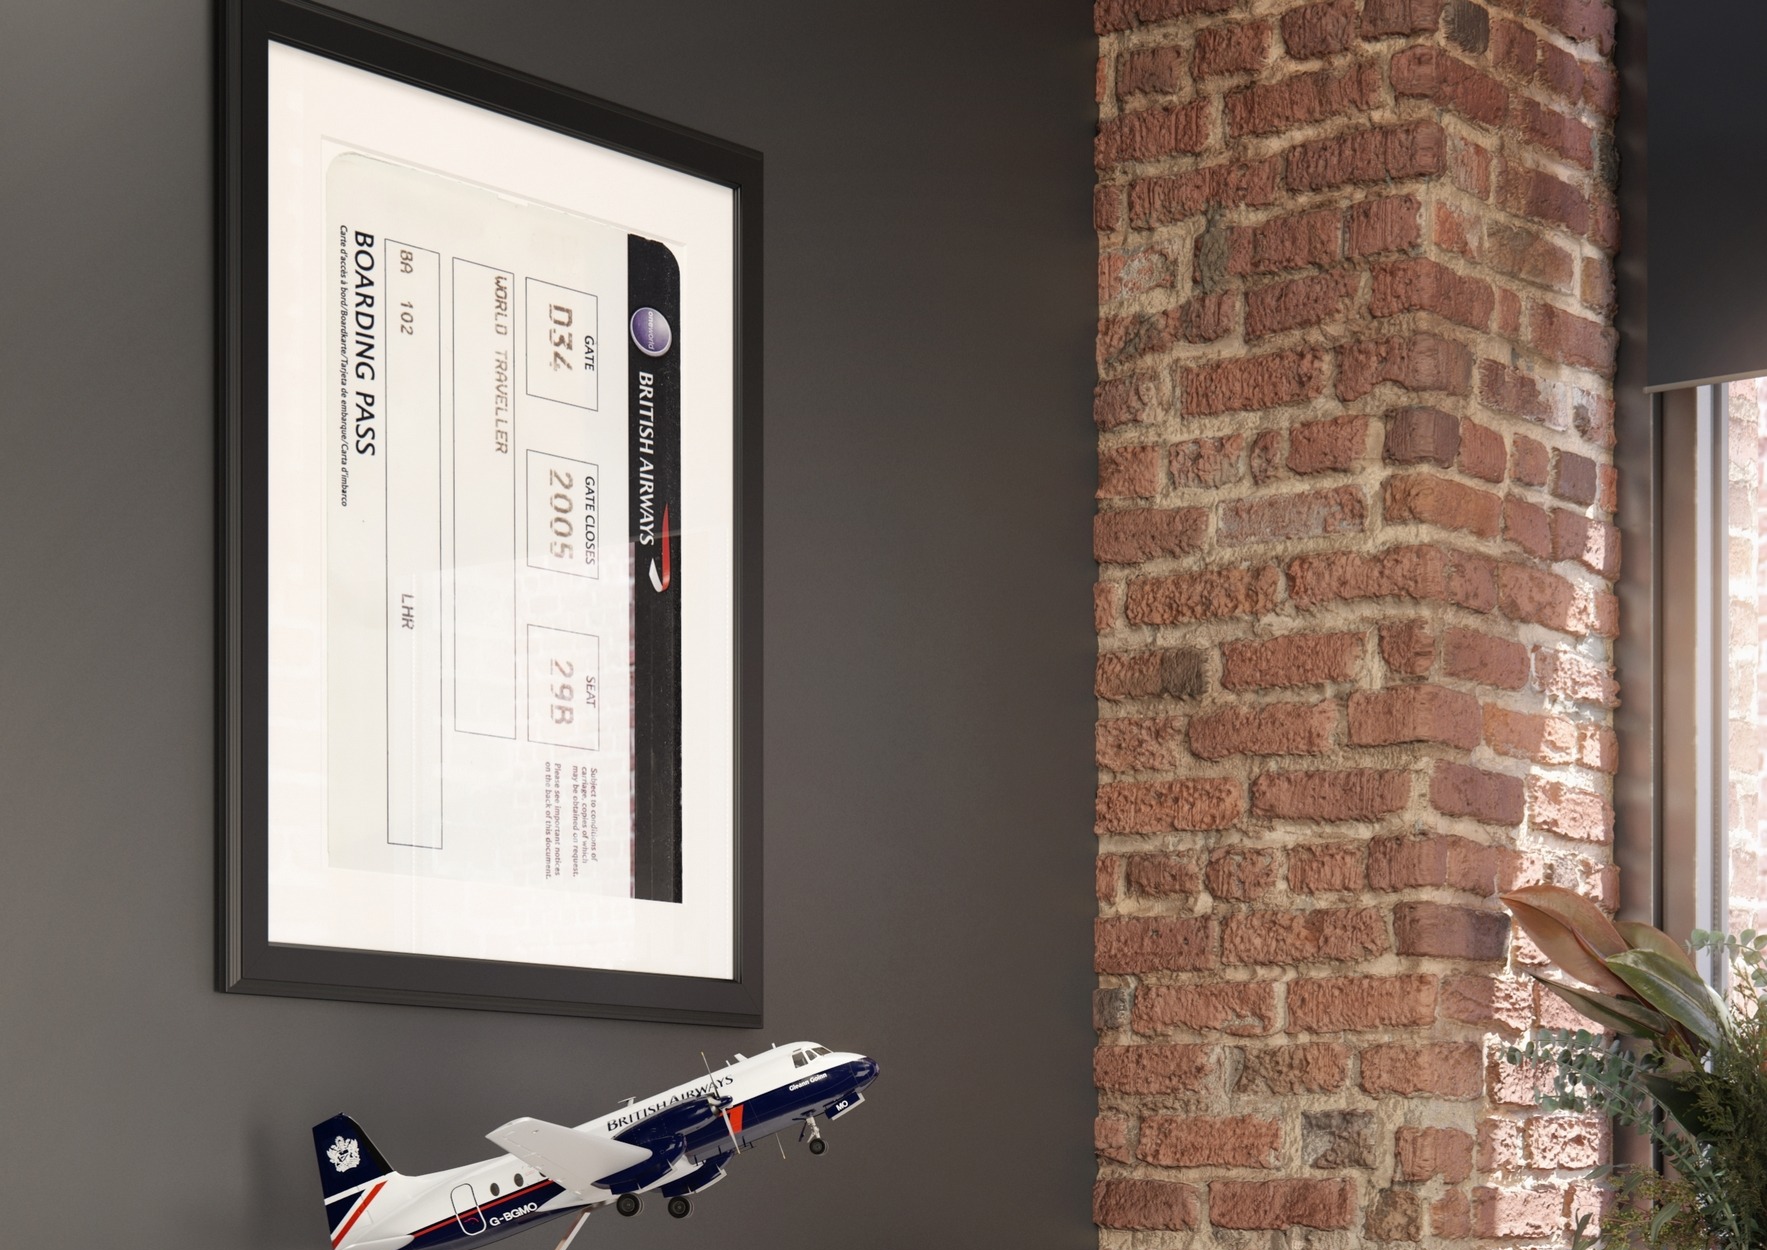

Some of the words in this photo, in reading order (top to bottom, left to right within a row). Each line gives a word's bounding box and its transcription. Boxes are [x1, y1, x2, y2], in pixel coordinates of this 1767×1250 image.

[340, 225, 348, 247] Carte
[400, 250, 414, 274] BA
[355, 230, 375, 381] BOARDING
[400, 301, 414, 335] 102
[495, 276, 508, 335] WORLD
[584, 335, 595, 371] GATE
[341, 388, 349, 398] de
[495, 349, 508, 454] TRAVELLER
[355, 391, 376, 456] PASS
[639, 371, 655, 455] BRITISH
[340, 400, 349, 465] embarque/Carta
[585, 476, 595, 511] GATE
[639, 457, 655, 546] AIRWAYS
[550, 469, 573, 559] 2005
[585, 515, 596, 565] CLOSES
[402, 594, 415, 630] LHR
[551, 658, 574, 724] 29B
[586, 676, 596, 709] SEAT
[545, 762, 551, 772] on
[590, 768, 598, 797] Subject
[573, 784, 580, 794] be
[591, 800, 597, 808] to
[545, 810, 552, 820] of
[553, 806, 561, 845] important
[573, 833, 579, 843] on
[582, 830, 589, 839] of
[554, 847, 562, 876] notices
[591, 853, 598, 862] of
[607, 1100, 667, 1131] BRITISH
[669, 1074, 734, 1105] AIRWAYS
[835, 1100, 849, 1111] MO
[489, 1202, 538, 1226] G-BGMO
